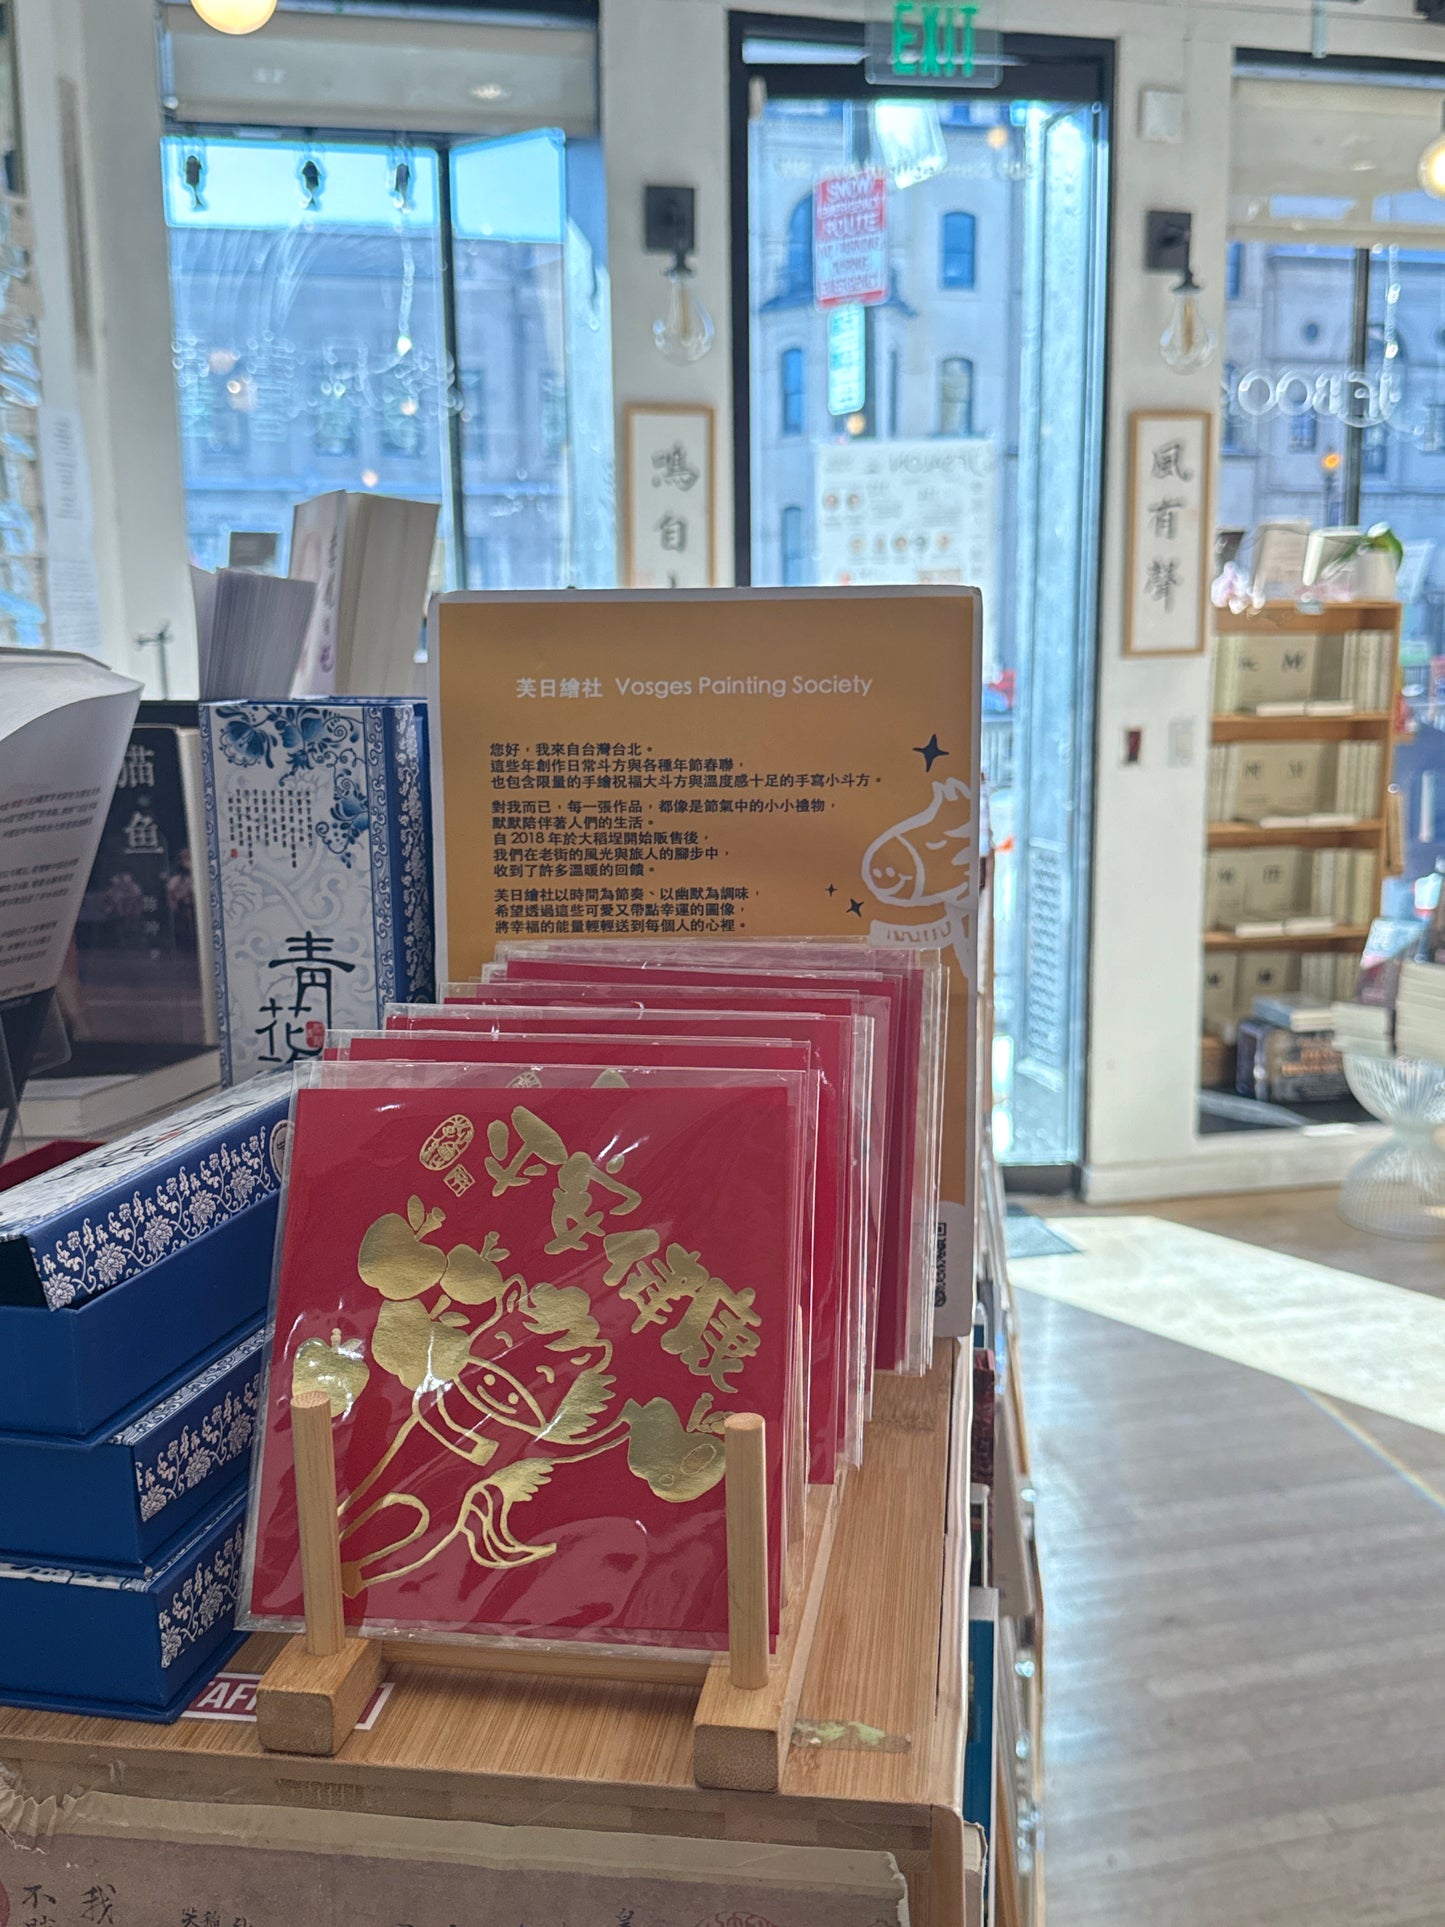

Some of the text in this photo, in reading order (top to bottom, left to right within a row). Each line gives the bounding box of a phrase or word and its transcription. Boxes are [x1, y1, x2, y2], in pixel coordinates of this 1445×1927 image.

[893, 2, 977, 77] EXIT
[827, 175, 871, 197] SNOW
[651, 442, 700, 588] 鳴自
[1145, 440, 1194, 614] 風有聲
[516, 674, 873, 699] 芙日繪社 Vosges Painting Society
[490, 742, 653, 757] 您好，我來自台灣台北。
[494, 832, 507, 846] 自
[511, 831, 545, 844] 2018
[485, 1105, 762, 1393] 平安健康
